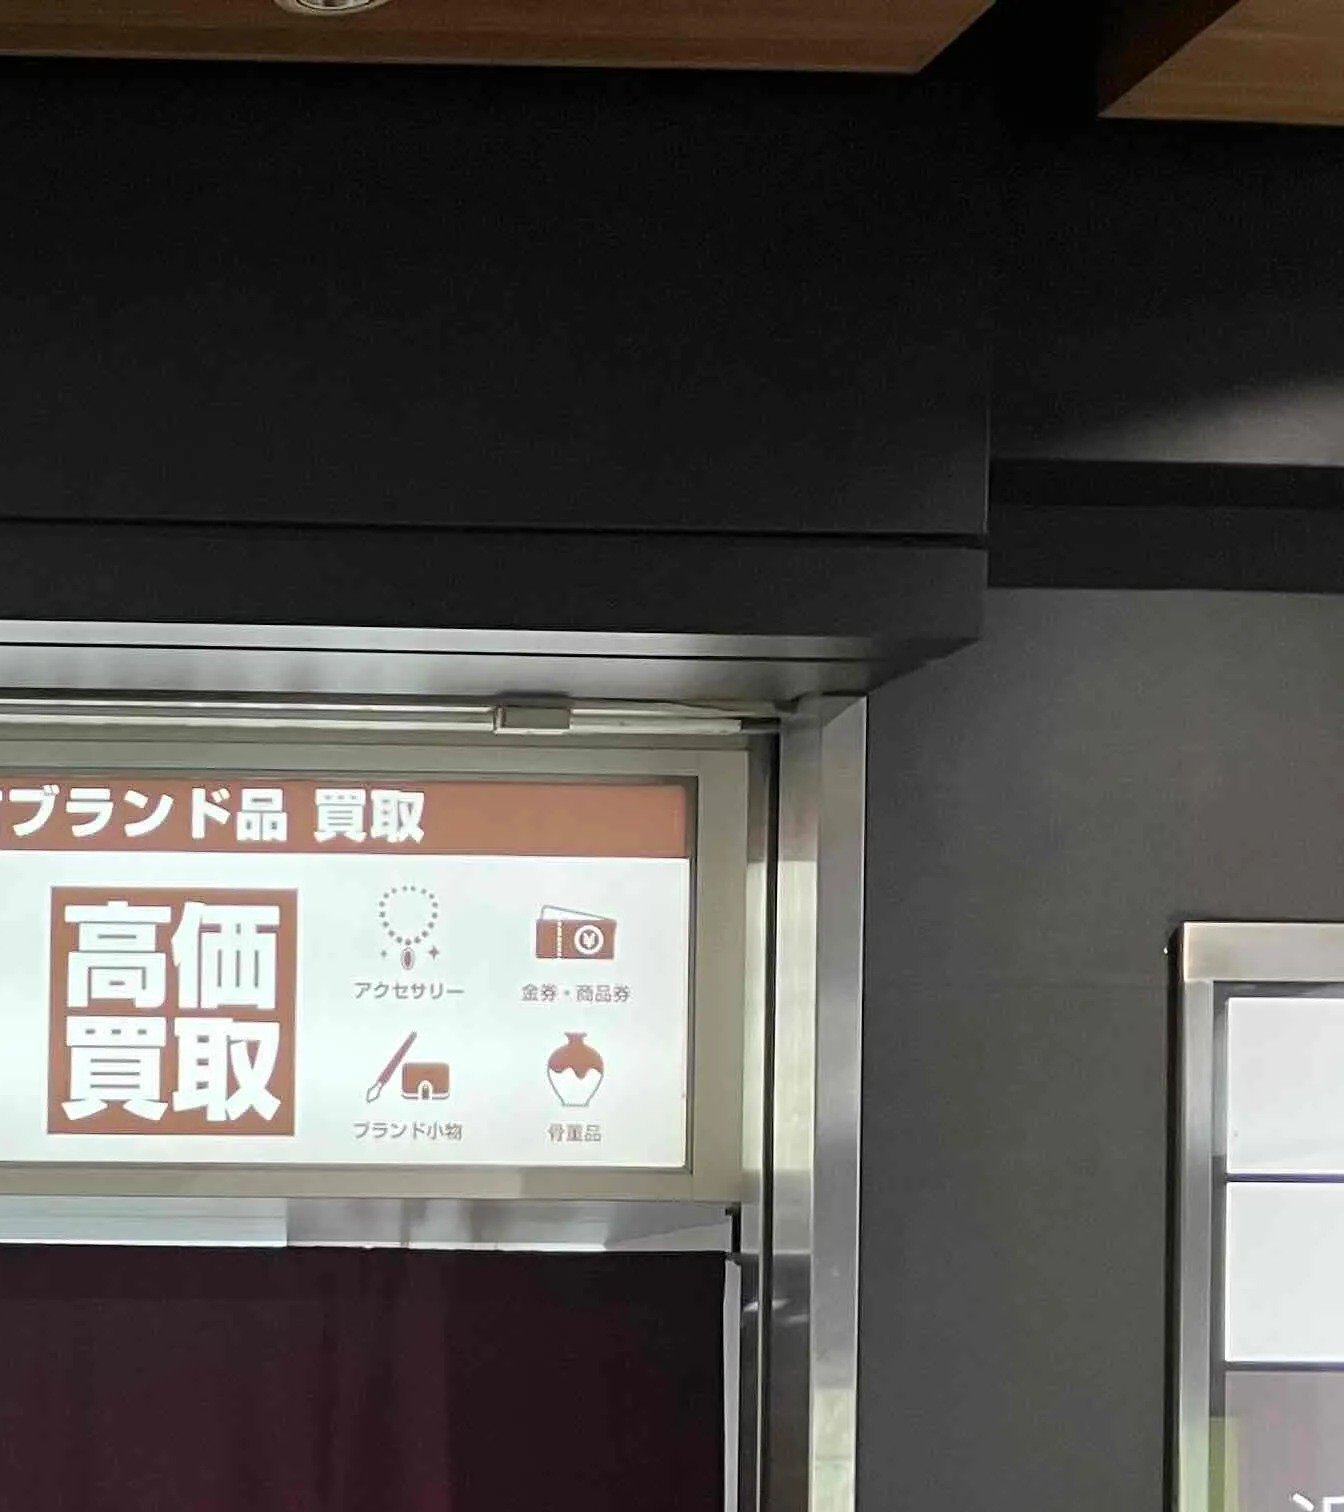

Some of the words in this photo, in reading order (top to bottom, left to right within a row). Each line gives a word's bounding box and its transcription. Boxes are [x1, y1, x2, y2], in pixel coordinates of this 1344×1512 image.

[313, 787, 427, 846] 買取
[62, 900, 282, 1011] 高価
[354, 981, 465, 1000] アクセサリー
[60, 1013, 283, 1124] 買取
[353, 1121, 463, 1141] ブランド小物
